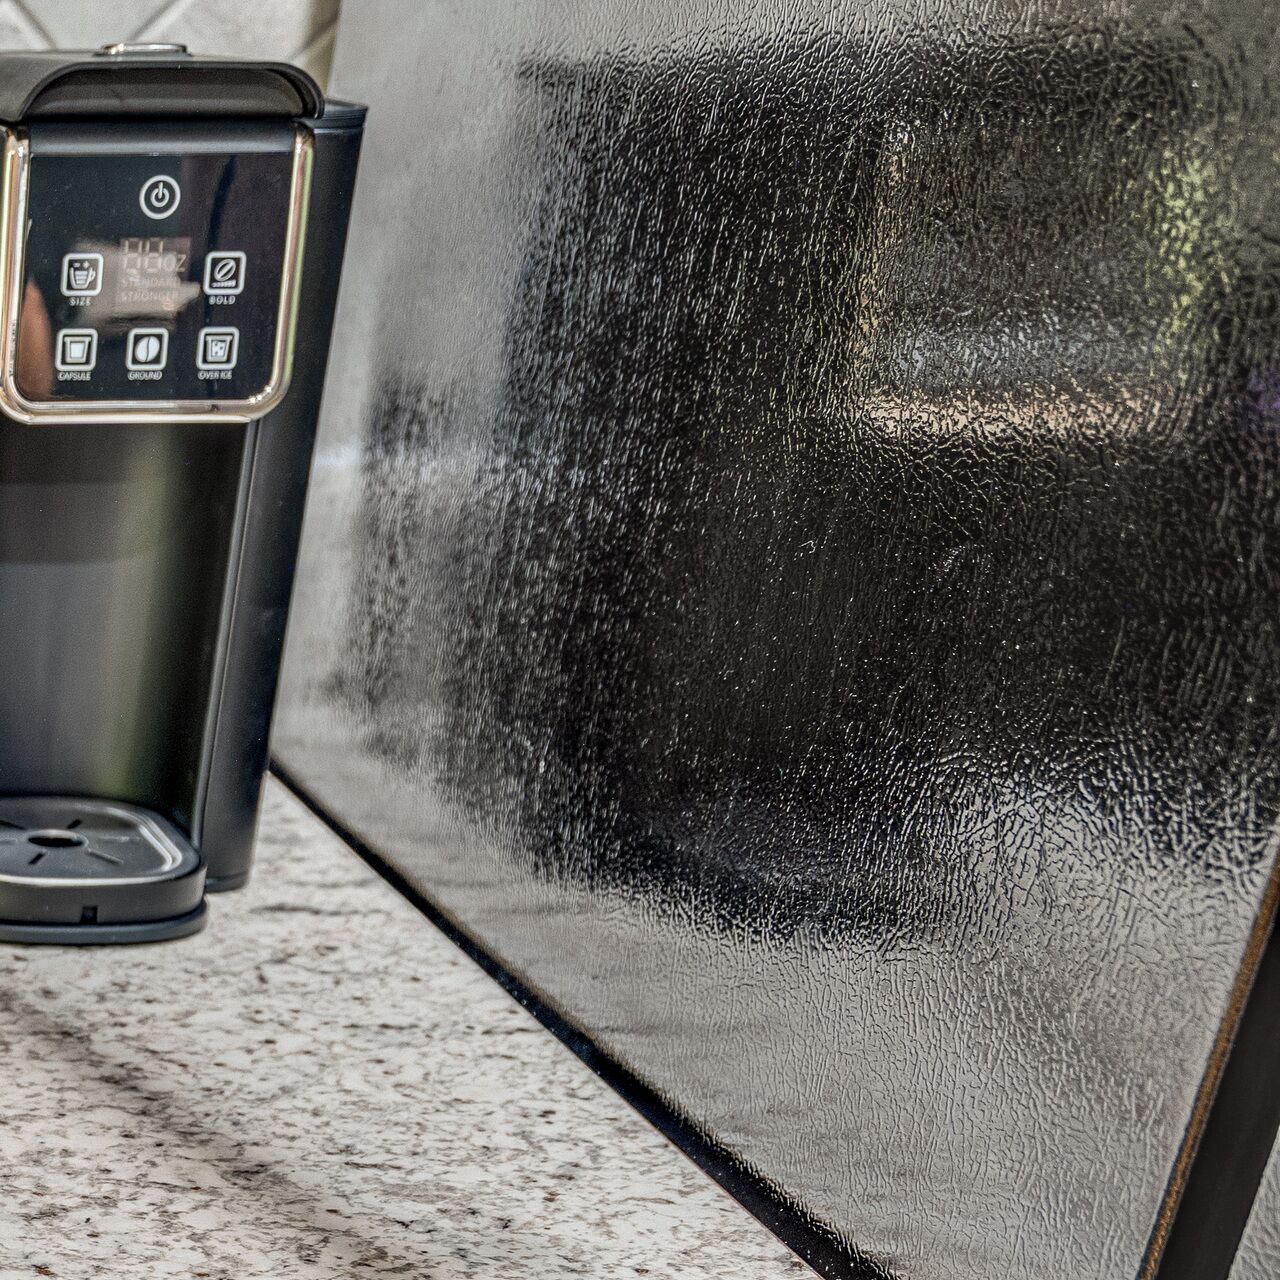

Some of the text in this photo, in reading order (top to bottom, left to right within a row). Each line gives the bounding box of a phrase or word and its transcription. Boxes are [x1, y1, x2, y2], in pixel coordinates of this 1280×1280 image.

[57, 371, 92, 381] CAPSULE
[127, 371, 163, 381] GROUND
[197, 371, 233, 380] OVER ICE
